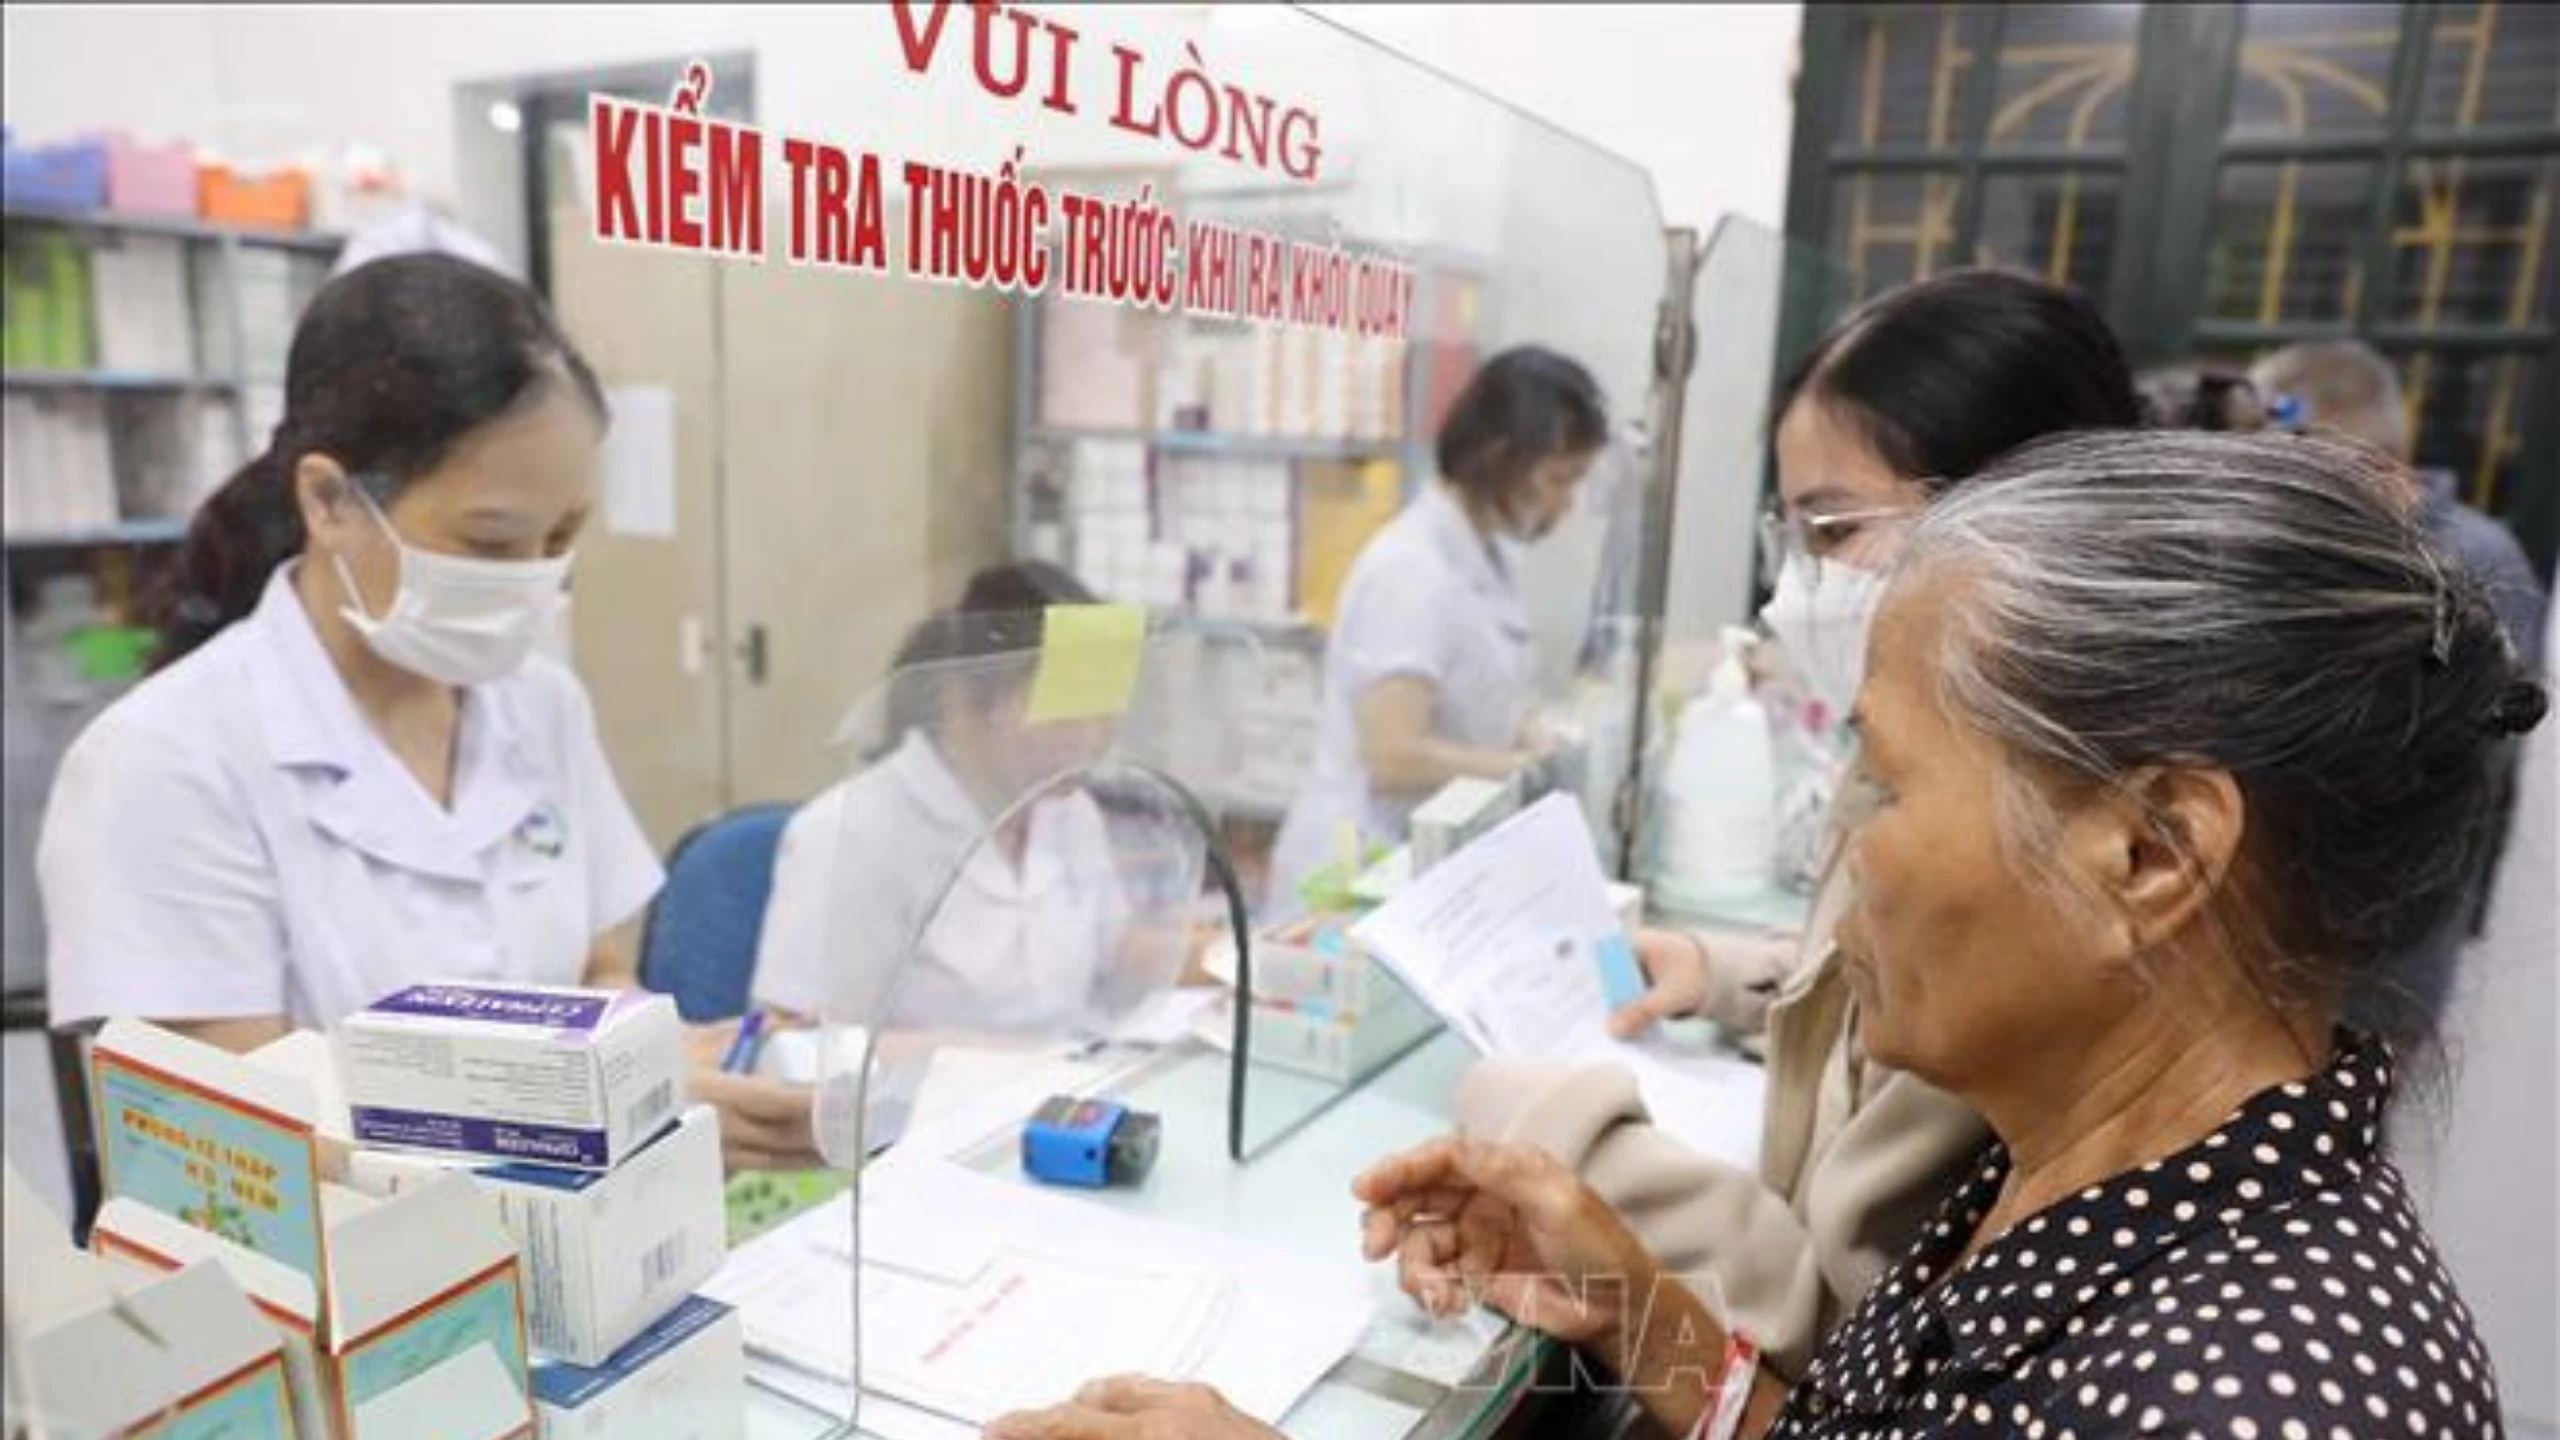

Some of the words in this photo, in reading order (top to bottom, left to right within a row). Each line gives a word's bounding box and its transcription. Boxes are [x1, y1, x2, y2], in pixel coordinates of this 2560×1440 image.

[595, 66, 763, 256] KIỂM
[784, 138, 887, 269] TRA
[904, 146, 1051, 287] THUỐC
[1061, 185, 1176, 306] TRƯỚC
[1185, 222, 1238, 314] KHI
[1247, 236, 1284, 320] RA
[887, 0, 1079, 115] VUI
[1109, 42, 1321, 180] LÒNG
